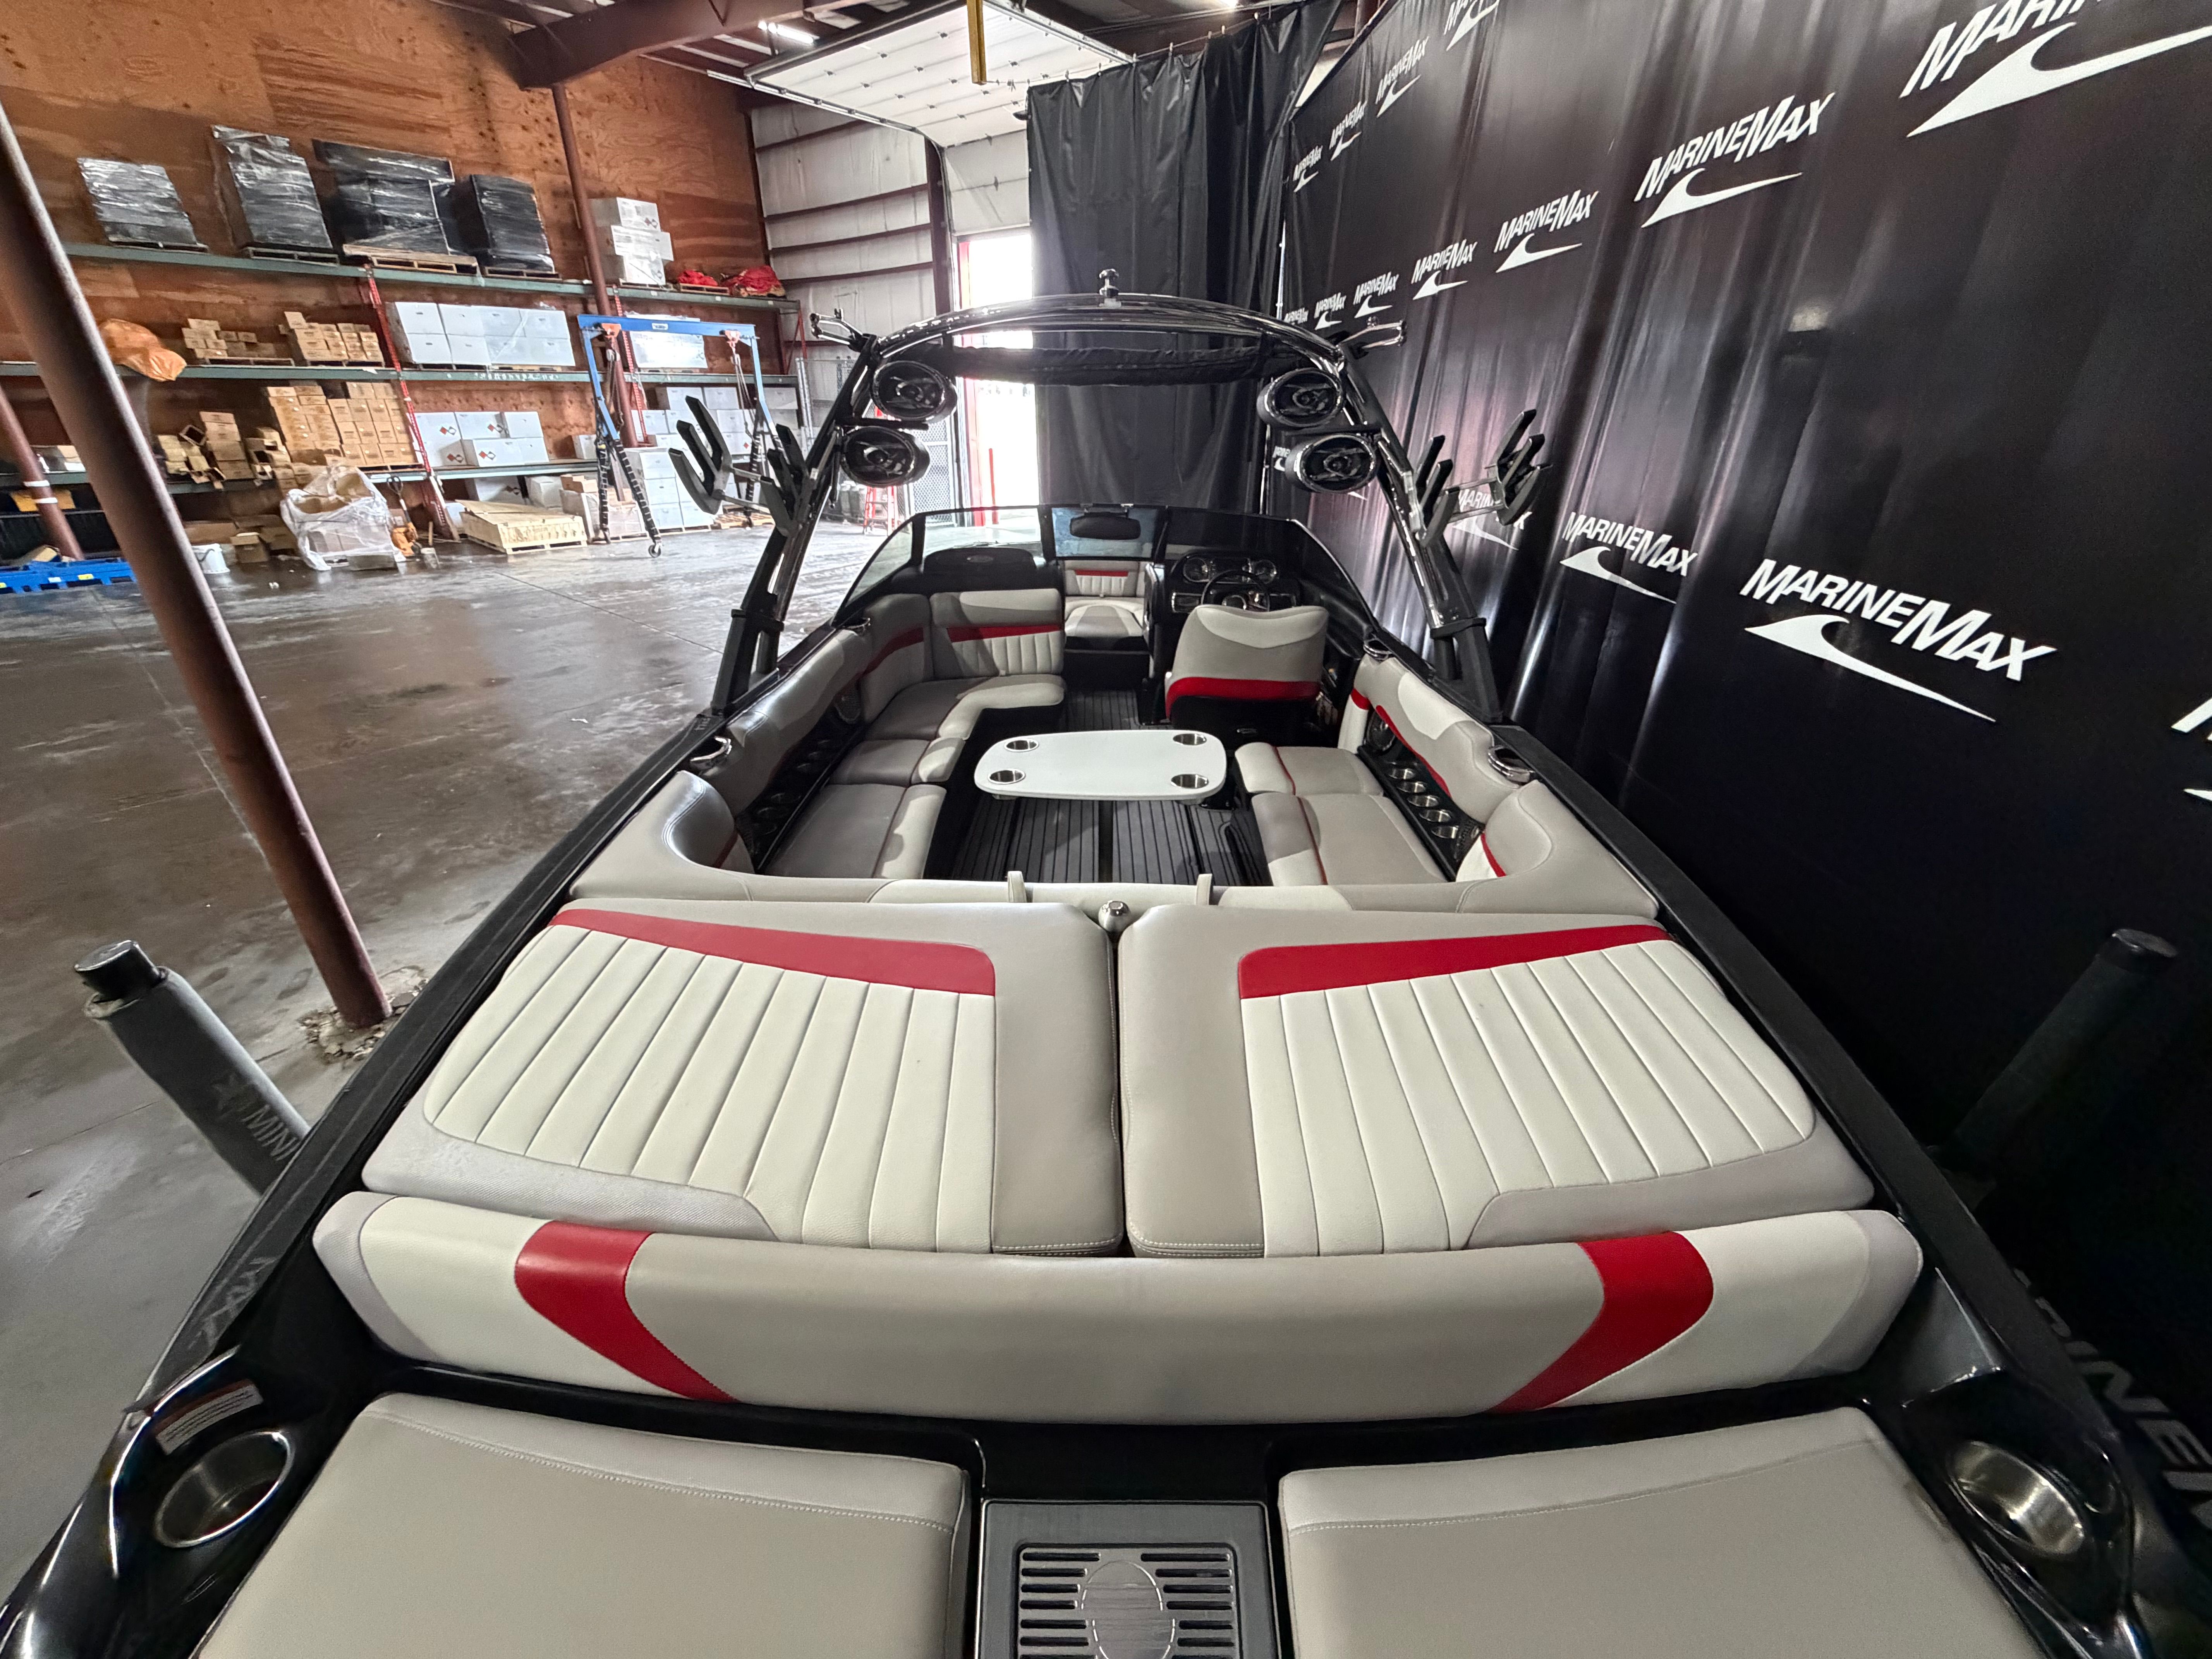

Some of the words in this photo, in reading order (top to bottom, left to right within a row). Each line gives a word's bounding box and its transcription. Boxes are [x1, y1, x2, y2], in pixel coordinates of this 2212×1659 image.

[1633, 92, 1836, 202] MARINEMAX
[1494, 189, 1599, 253] MARINEMAX
[1562, 512, 1698, 577] MARINEMAX
[1740, 559, 2058, 682] MARINEMAX
